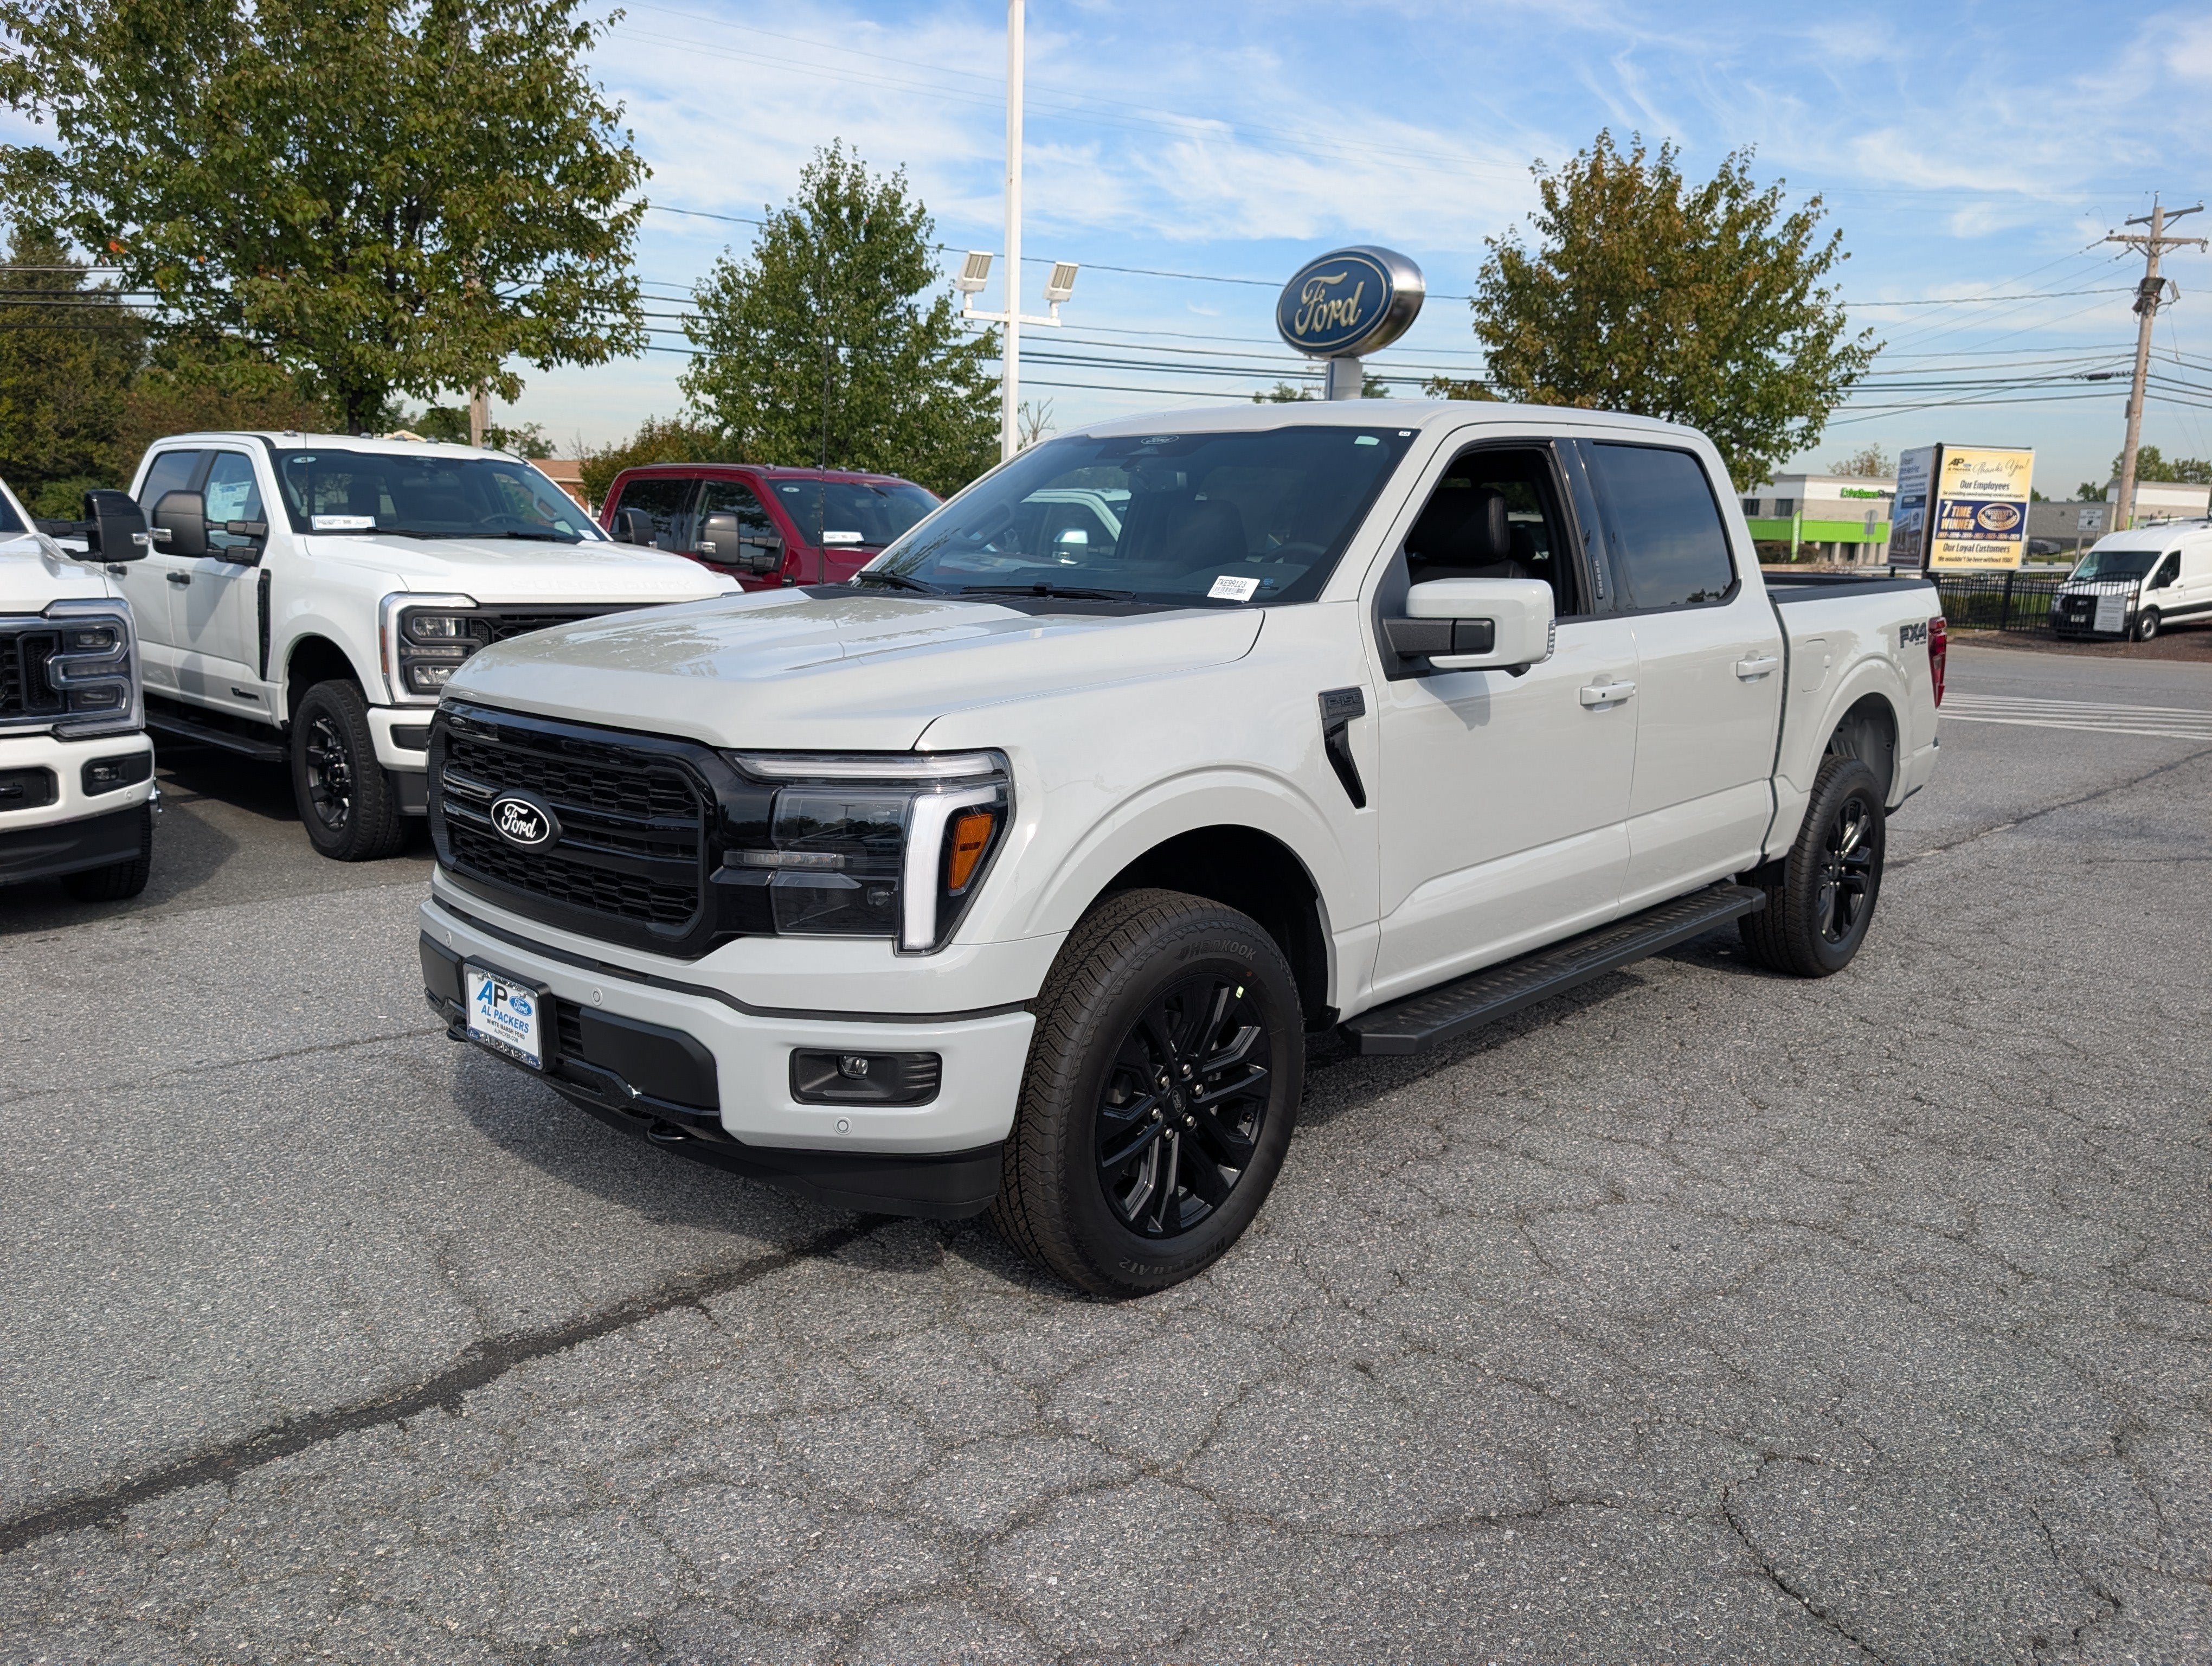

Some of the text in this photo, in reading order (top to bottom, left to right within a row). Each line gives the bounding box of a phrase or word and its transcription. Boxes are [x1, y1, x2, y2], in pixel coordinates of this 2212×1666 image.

[1294, 271, 1365, 336] Ford
[1972, 458, 2030, 477] Thanks You!
[1960, 479, 2010, 491] Our Employees
[1943, 500, 1974, 518] 7 TIME
[1941, 517, 1976, 530] WINNER
[1943, 543, 2010, 553] Our Loyal Customers
[1217, 579, 1247, 588] TKE99123
[1899, 622, 1926, 648] FX4
[501, 803, 537, 838] Ford
[477, 980, 508, 1008] AP
[513, 998, 529, 1014] Ford
[481, 1004, 529, 1033] AL PACKERS
[487, 1018, 525, 1040] WHITE MARSH FORD
